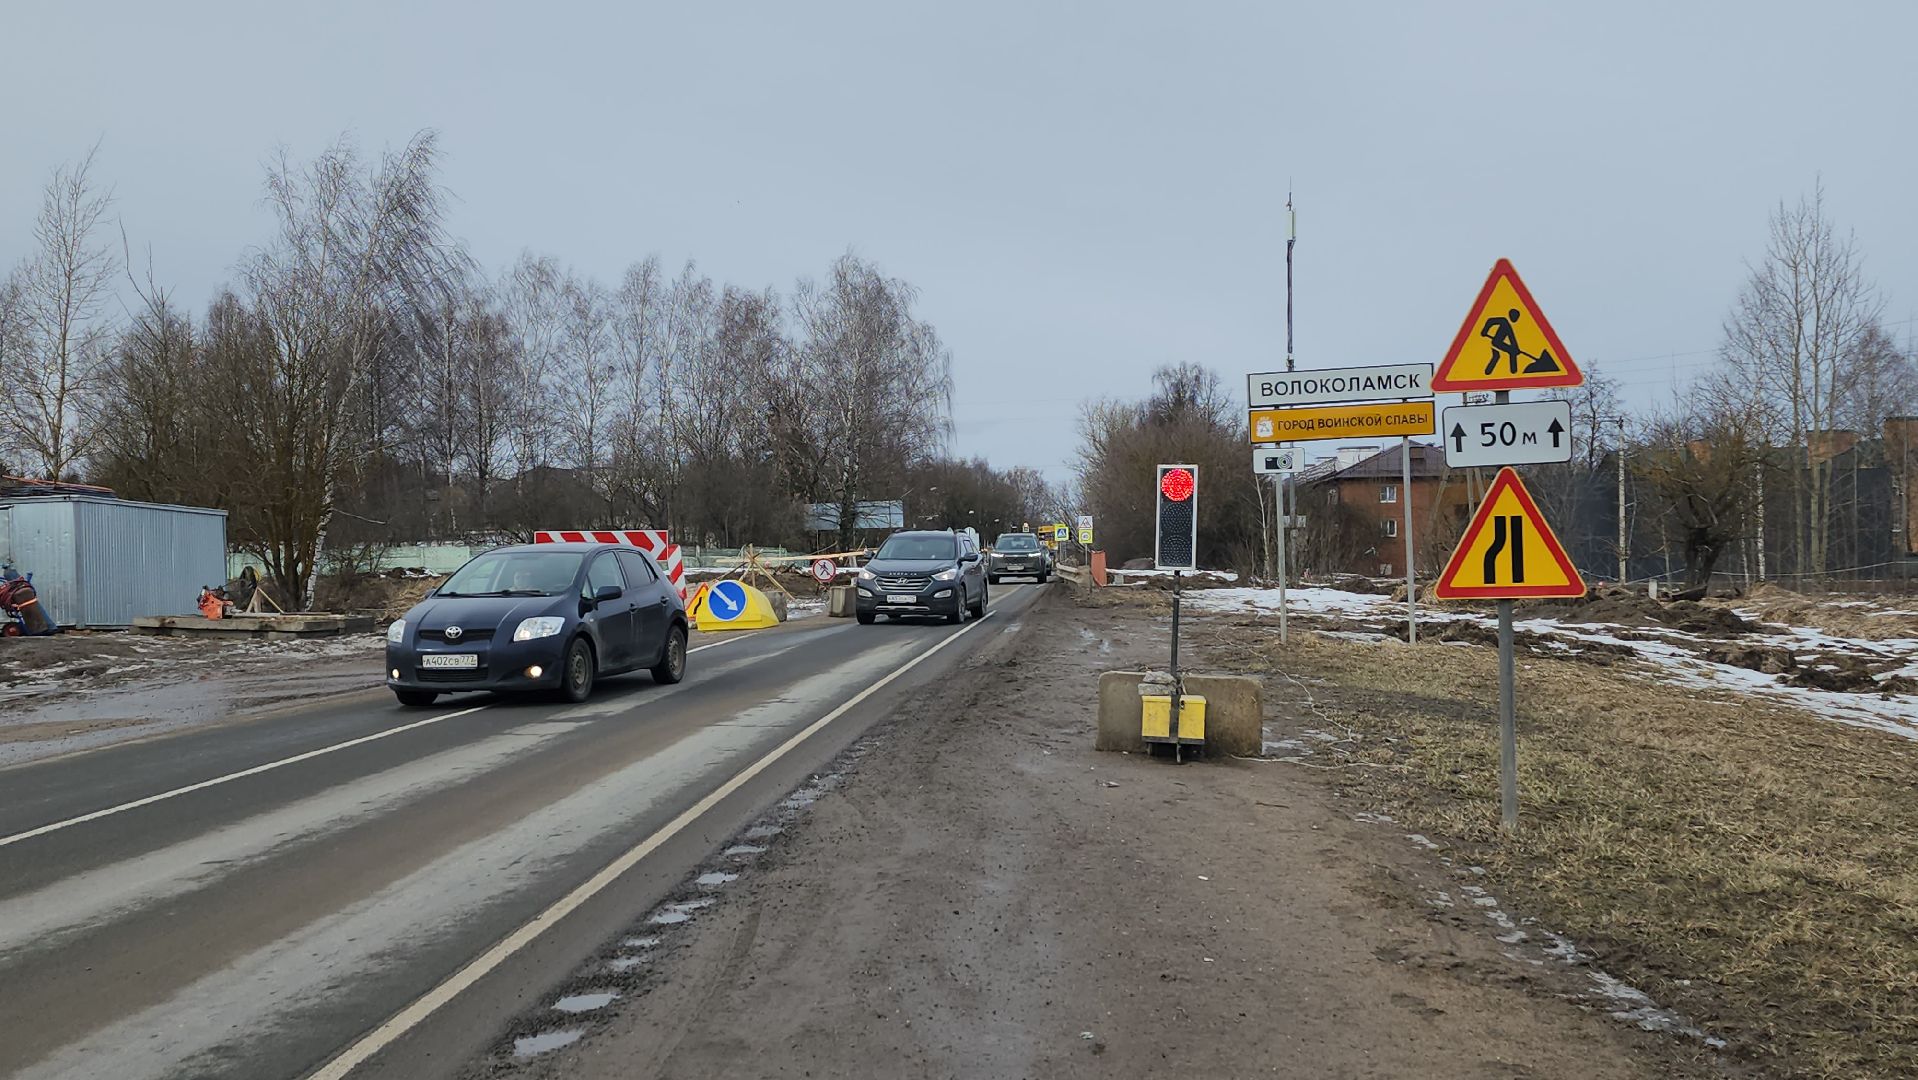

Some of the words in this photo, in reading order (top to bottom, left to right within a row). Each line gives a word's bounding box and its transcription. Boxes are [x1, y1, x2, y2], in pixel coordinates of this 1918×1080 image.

[1261, 374, 1420, 396] ВОЛОКОЛАМСК
[1278, 418, 1315, 431] ГОРОД
[1317, 413, 1382, 429] ВОИНСКОЙ
[1385, 413, 1428, 425] СЛАВЫ
[1480, 421, 1517, 447] 50
